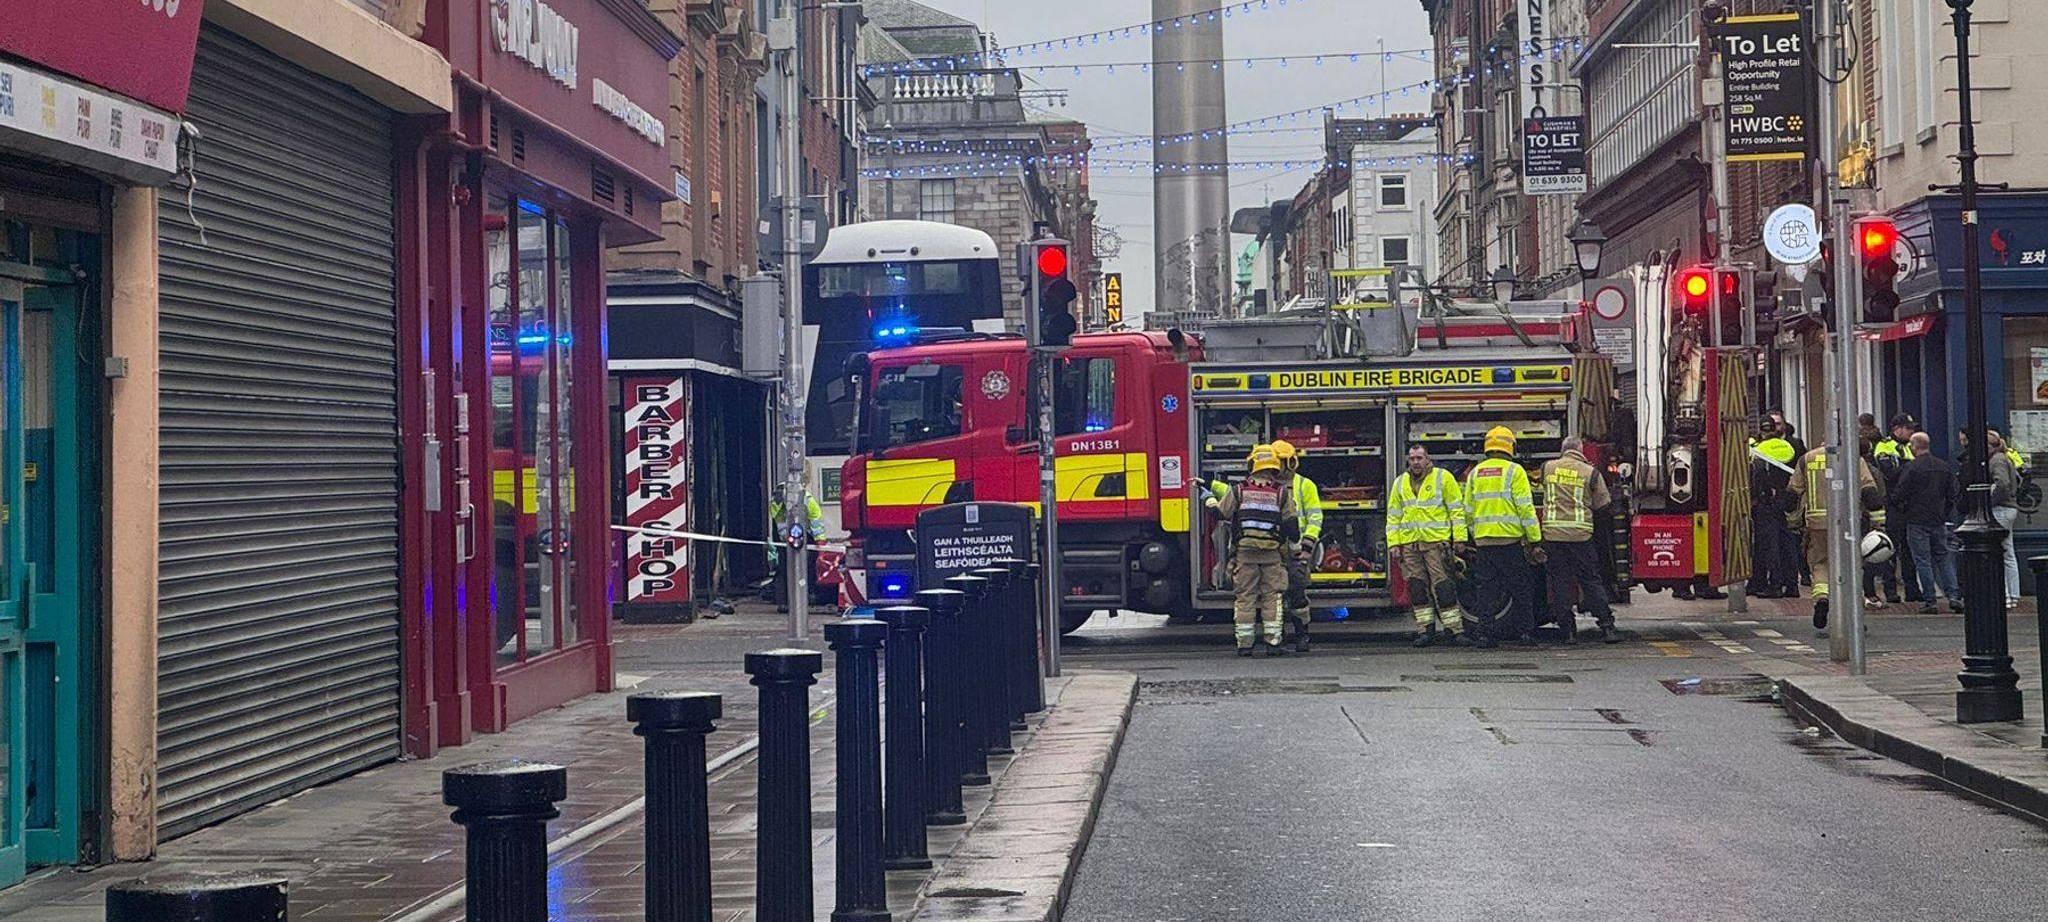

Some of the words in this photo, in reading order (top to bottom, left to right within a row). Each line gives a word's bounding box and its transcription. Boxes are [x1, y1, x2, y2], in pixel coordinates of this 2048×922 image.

[1725, 35, 1755, 55] To
[1763, 34, 1800, 53] Let
[1728, 61, 1747, 70] High
[1749, 59, 1777, 68] Profile
[1728, 70, 1780, 80] Opportunity
[1751, 83, 1780, 91] Building
[1730, 116, 1784, 133] HWBC
[1527, 134, 1548, 147] TO
[1553, 133, 1579, 146] LET
[1280, 372, 1346, 387] DUBLIN
[1353, 371, 1393, 386] FIRE
[1399, 369, 1482, 384] BRIGADE
[637, 386, 674, 500] BARBER
[1071, 439, 1120, 451] DN13B1
[934, 538, 952, 546] GAN
[935, 545, 1013, 557] LEITHSCÉALTA
[638, 520, 676, 597] SHOP
